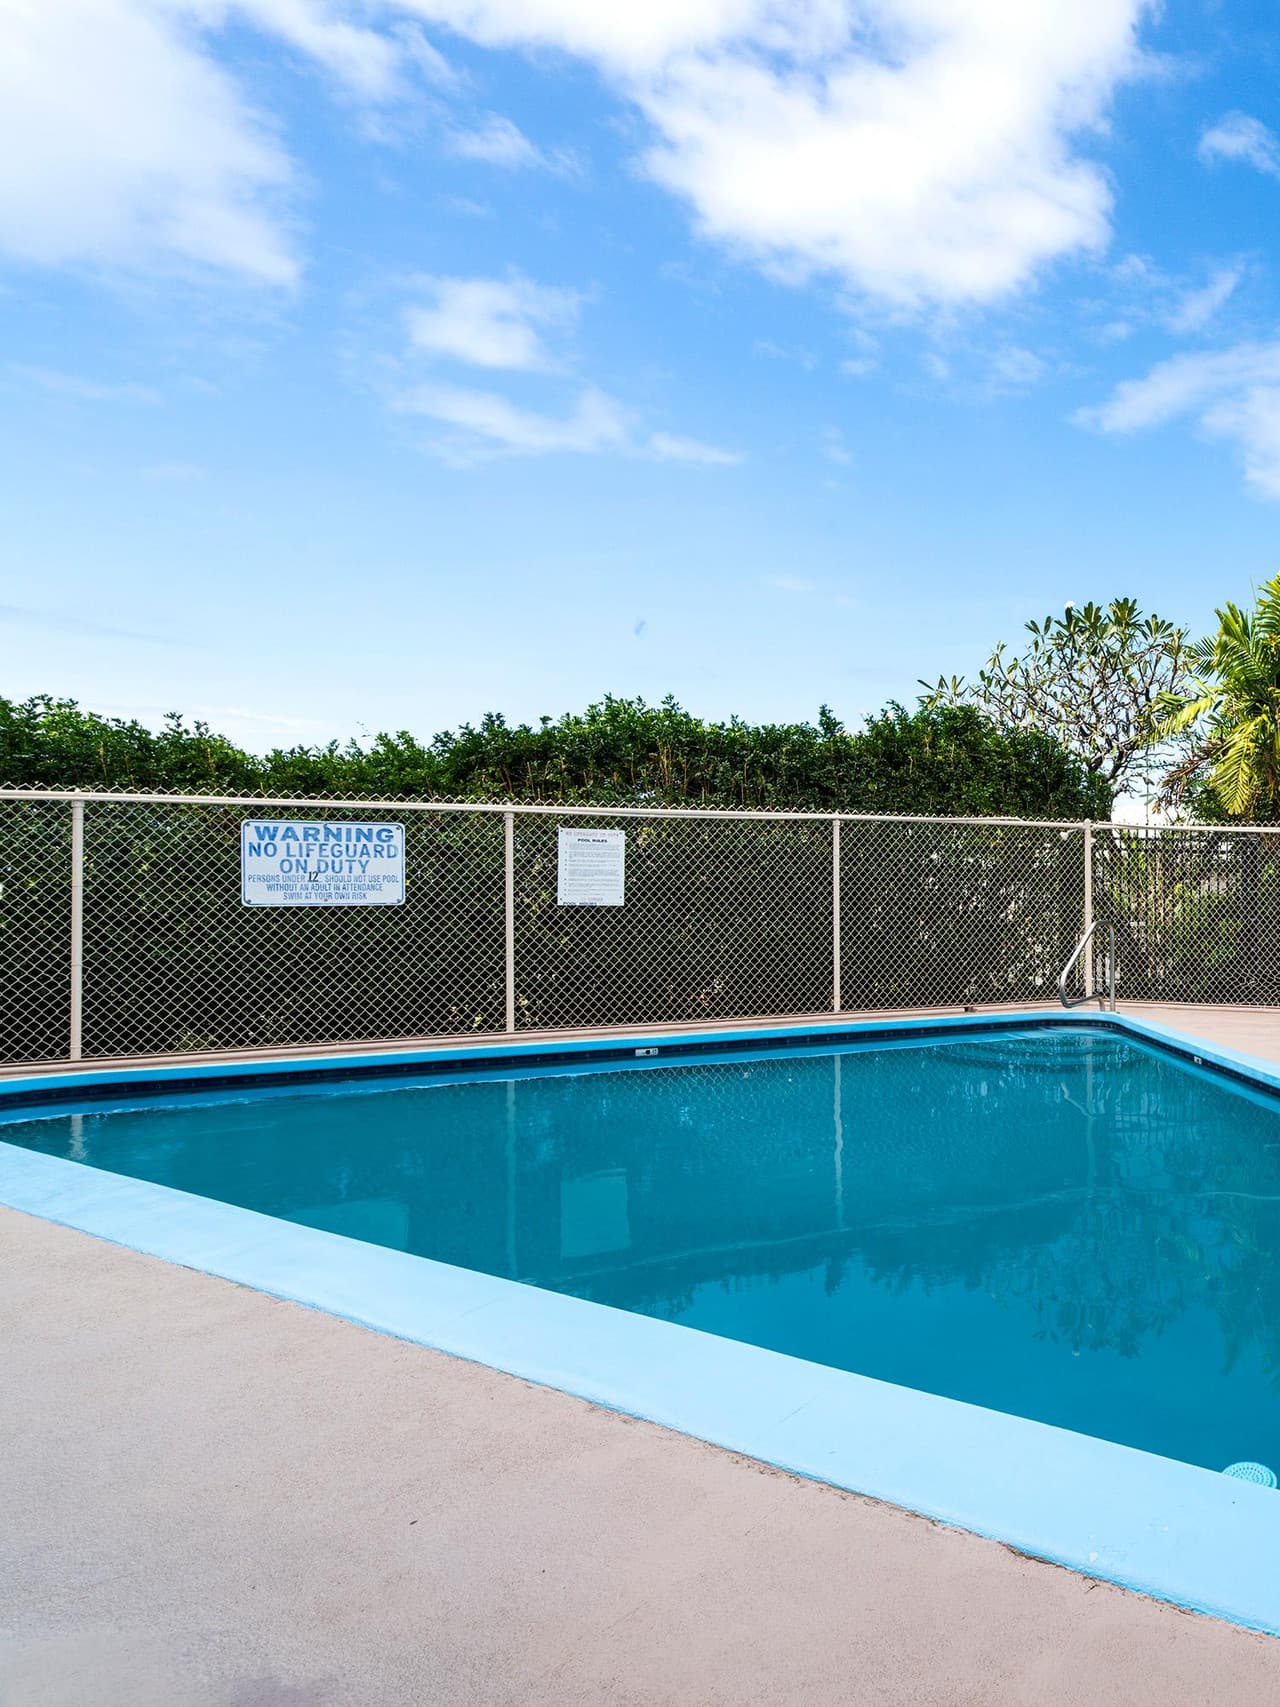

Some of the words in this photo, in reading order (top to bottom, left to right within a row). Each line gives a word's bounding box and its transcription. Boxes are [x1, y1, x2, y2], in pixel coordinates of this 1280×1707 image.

[254, 826, 394, 843] WARNING
[248, 842, 278, 858] NO
[286, 842, 399, 859] LIFEGUARD
[279, 859, 308, 874] ON
[317, 859, 370, 874] DUTY
[248, 874, 280, 883] PERSONS
[282, 874, 306, 883] UNDER
[307, 871, 319, 883] 12
[324, 874, 352, 883] SHOULD
[354, 874, 366, 883] NOT
[368, 875, 381, 883] USE
[382, 874, 399, 883] POOL
[266, 883, 298, 892] WITHOUT
[299, 883, 309, 892] AN
[311, 883, 332, 892] ADULT
[333, 883, 341, 892] IN
[342, 883, 384, 892] ATTENDANCE
[283, 891, 303, 900] SWIM
[304, 891, 312, 900] AT
[313, 891, 333, 900] YOUR
[334, 891, 351, 900] OWN
[351, 891, 368, 900] RISK
